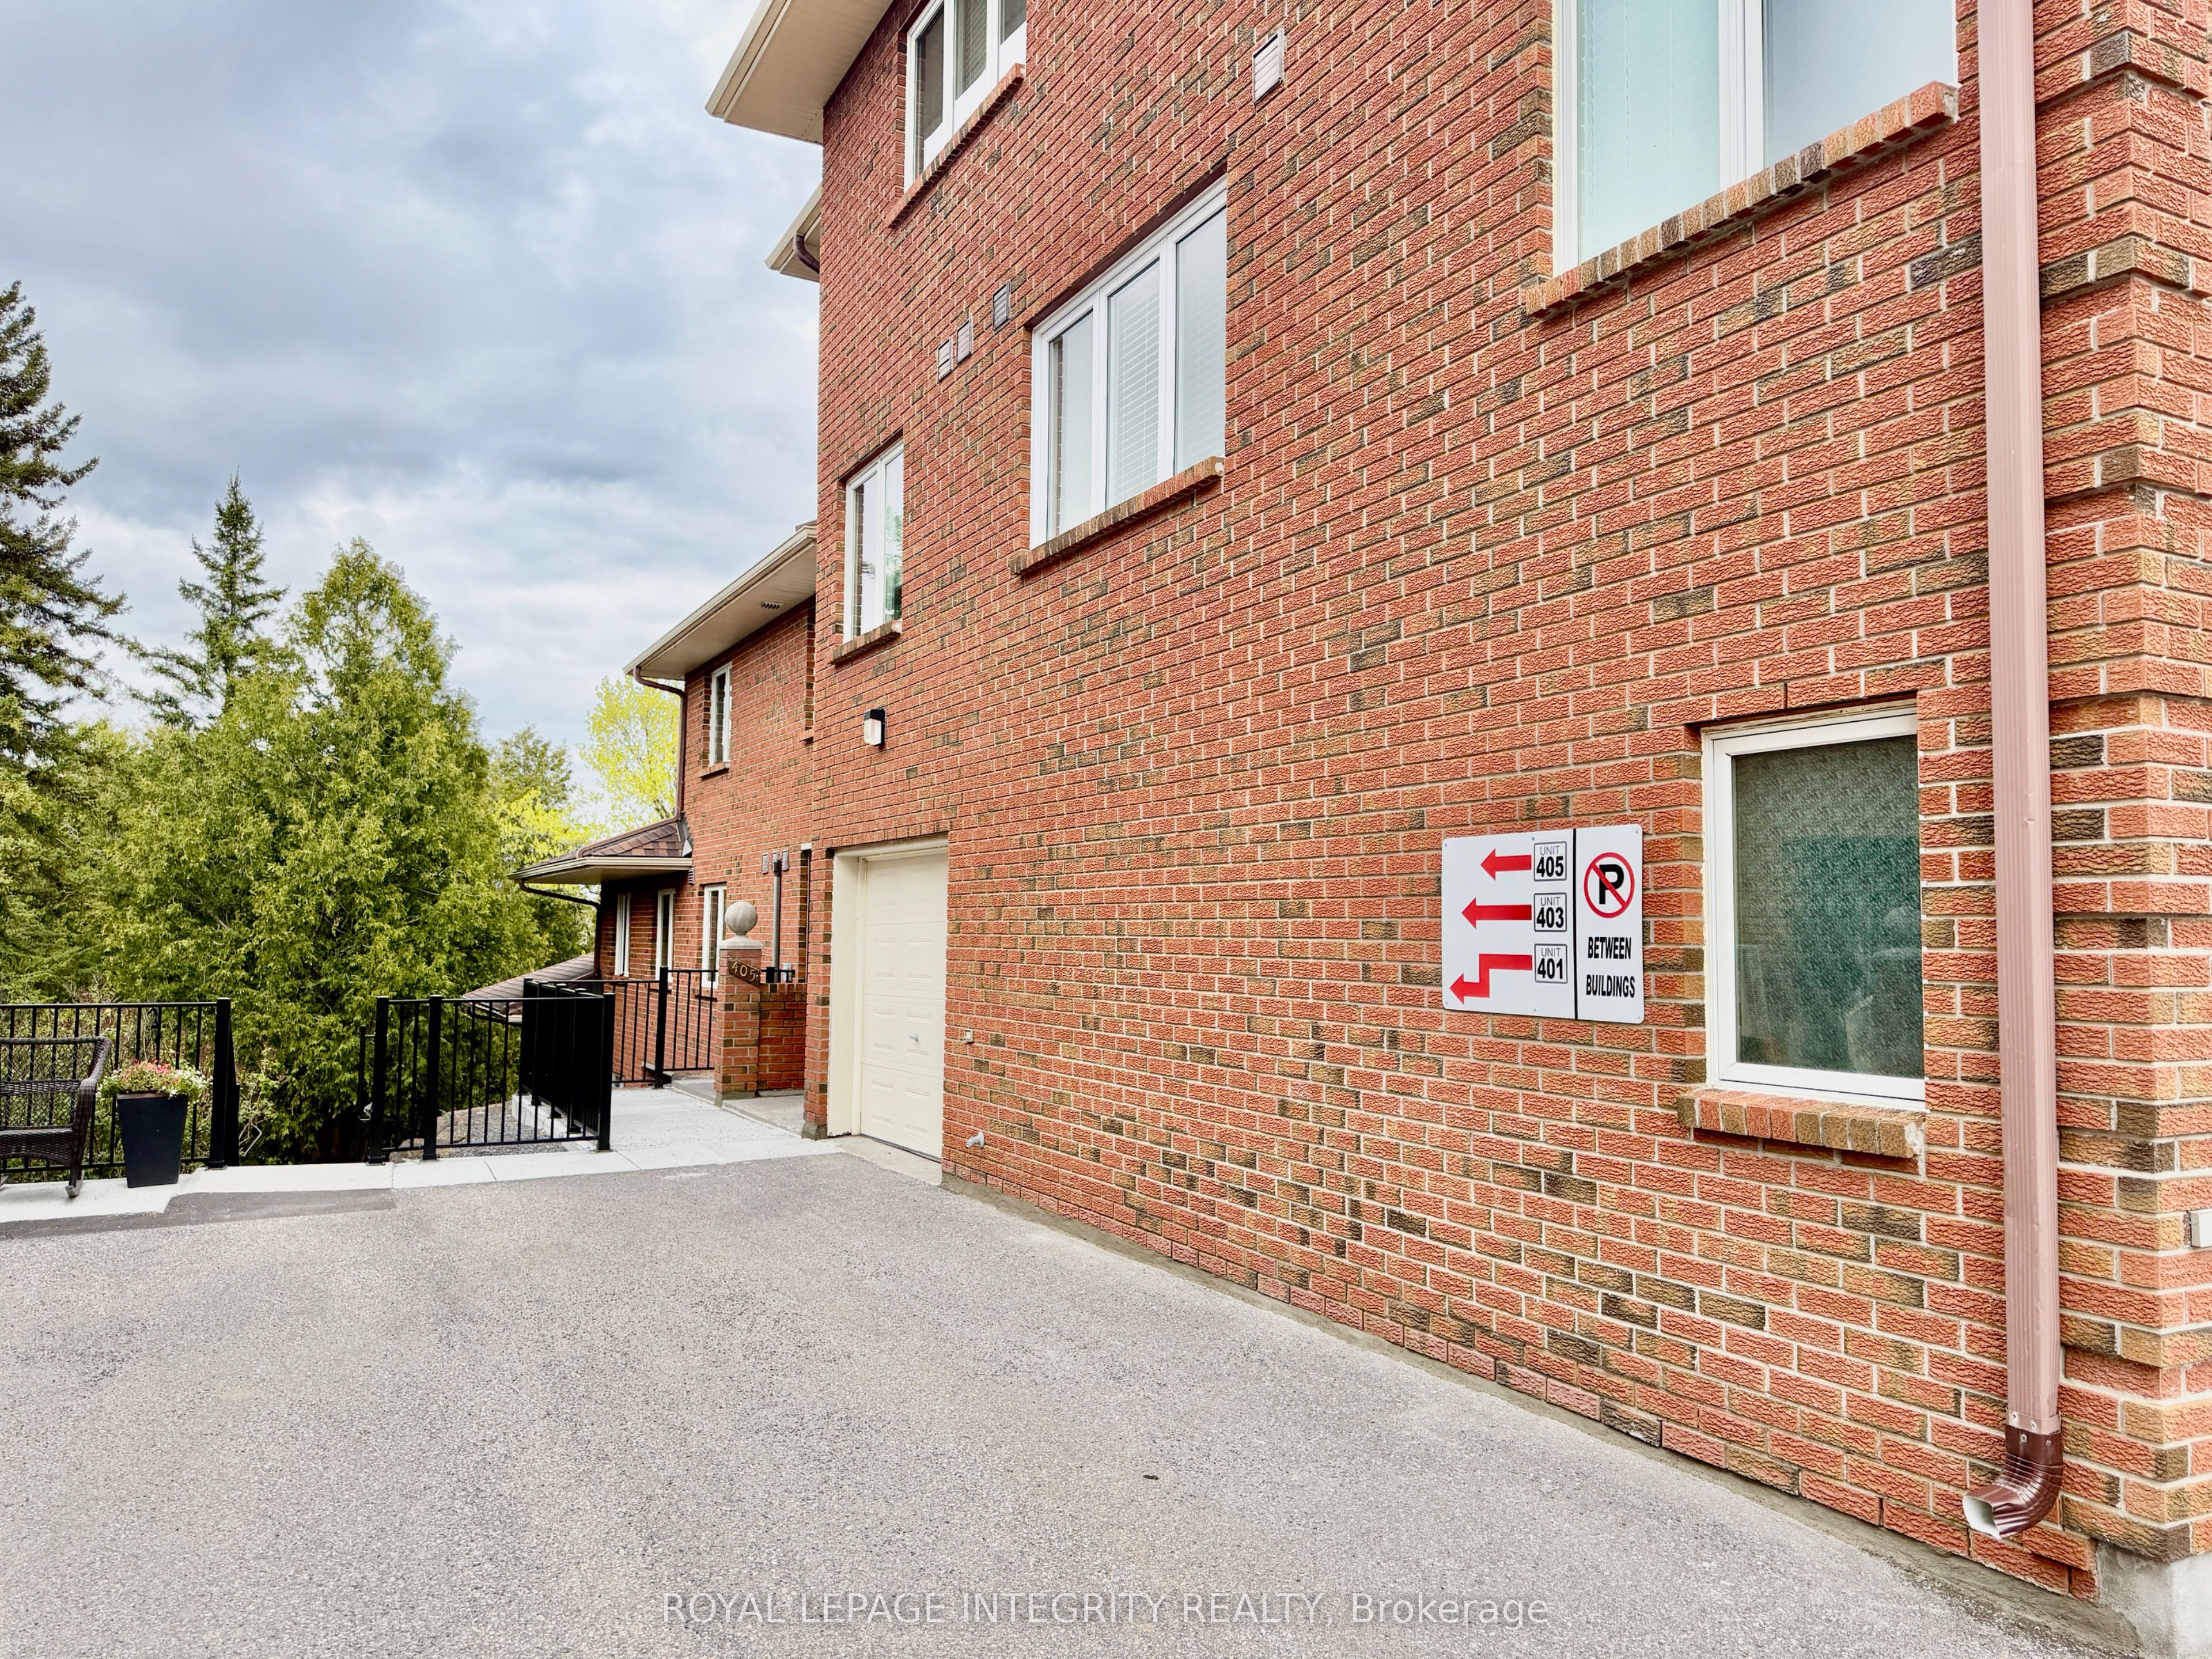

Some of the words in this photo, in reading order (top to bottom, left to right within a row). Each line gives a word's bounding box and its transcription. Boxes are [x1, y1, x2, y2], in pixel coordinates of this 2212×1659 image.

[1540, 845, 1560, 855] UNIT
[1536, 855, 1564, 877] 405
[1599, 863, 1624, 904] P
[1540, 896, 1560, 906] UNIT
[1536, 907, 1564, 928] 403
[1541, 948, 1561, 957] UNIT
[1587, 937, 1632, 960] BETWEEN
[732, 960, 756, 981] 405
[1537, 957, 1563, 979] 401
[1585, 974, 1635, 998] BUILDINGS
